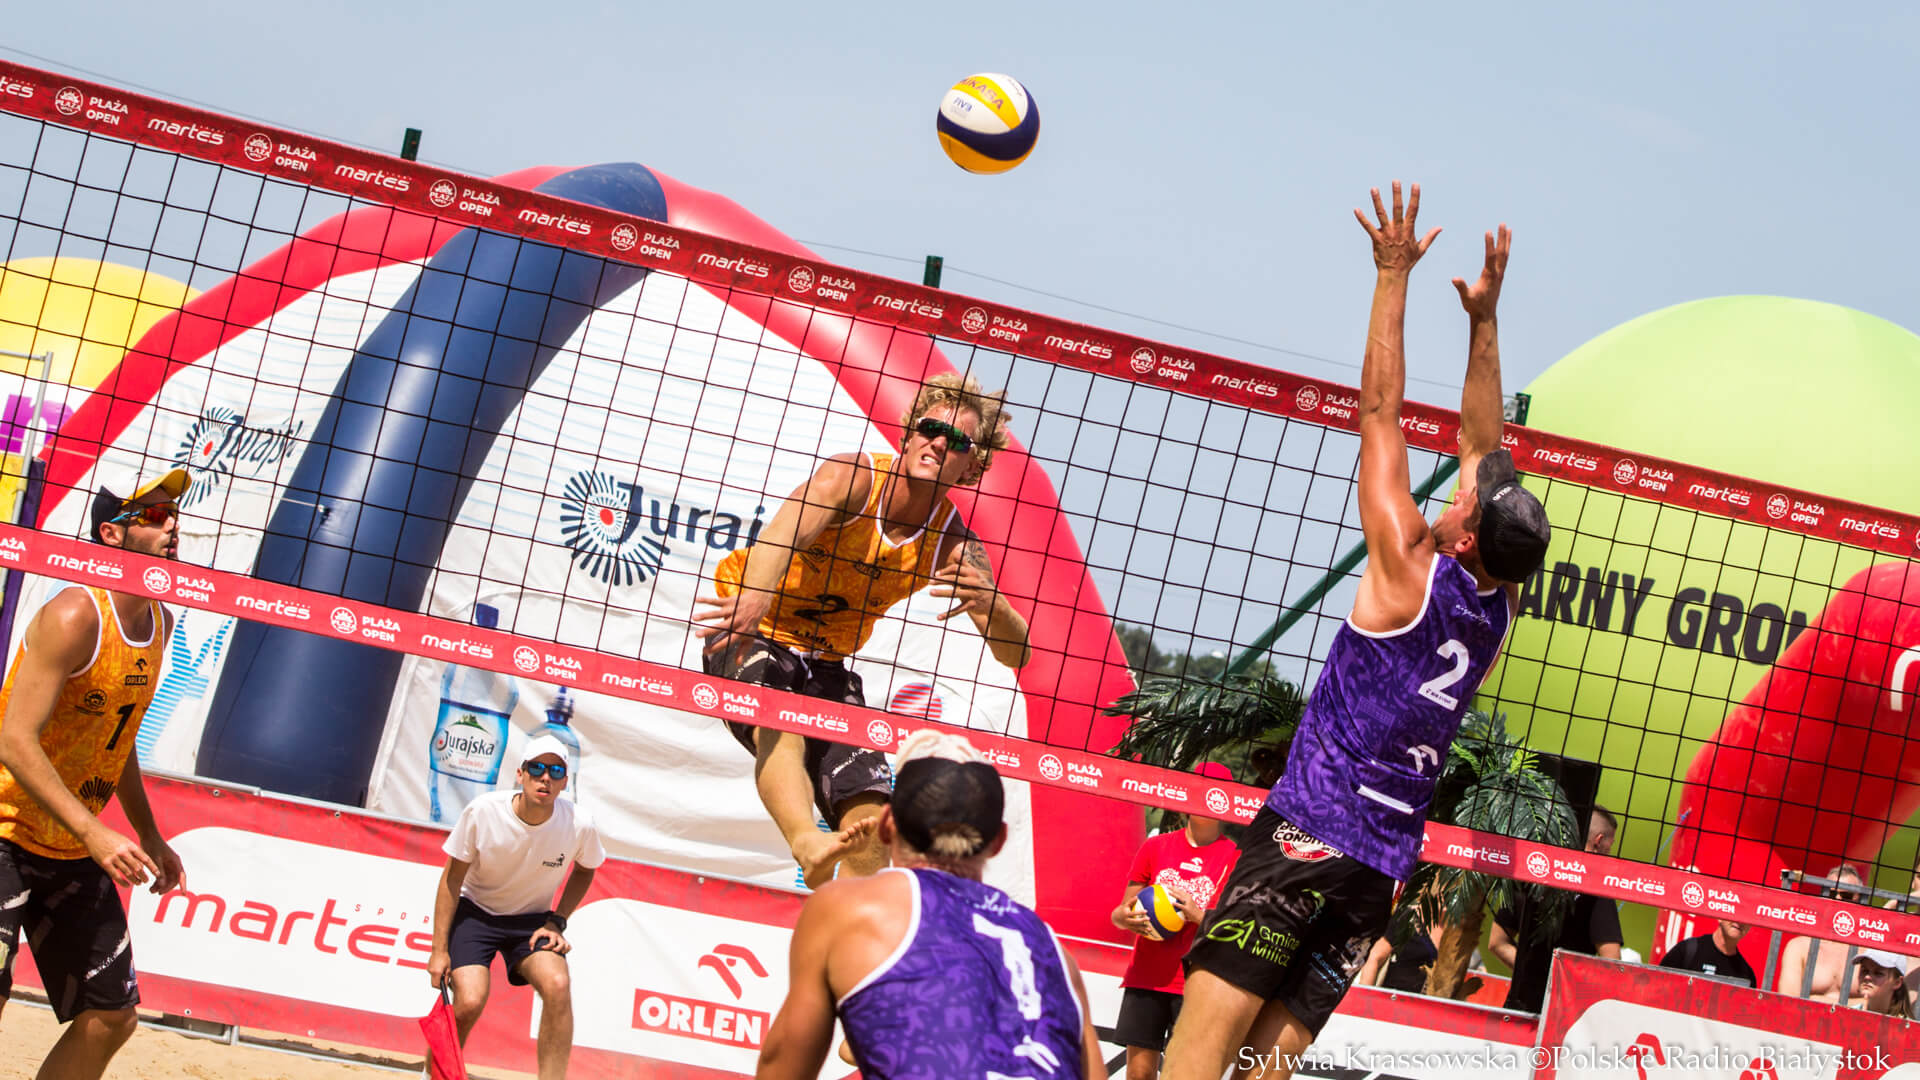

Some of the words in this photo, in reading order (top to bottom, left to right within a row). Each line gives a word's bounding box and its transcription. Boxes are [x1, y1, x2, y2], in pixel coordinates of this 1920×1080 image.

[89, 95, 129, 115] PLAŻA
[86, 110, 119, 126] OPEN
[147, 117, 224, 145] martes
[278, 142, 317, 162] PLAŻA
[275, 156, 308, 172] OPEN
[334, 163, 409, 192] martes
[462, 188, 500, 206] PLAŻA
[459, 201, 492, 216] OPEN
[518, 209, 592, 234] martes
[643, 232, 680, 249] PLAŻA
[640, 245, 672, 260] OPEN
[698, 252, 769, 278] martes
[820, 274, 856, 292] PLAŻA
[817, 287, 848, 301] OPEN
[873, 294, 944, 319] martes
[992, 316, 1028, 332] PLAŻA
[989, 328, 1020, 342] OPEN
[1044, 335, 1112, 360] martes
[1161, 354, 1196, 371] PLAŻA
[1158, 368, 1188, 381] OPEN
[1212, 374, 1278, 397] martes
[1326, 393, 1359, 408] PLAŻA
[1322, 406, 1352, 419] OPEN
[1534, 449, 1598, 471] martes
[1641, 467, 1674, 482] PLAŻA
[1639, 478, 1667, 492] OPEN
[1688, 484, 1750, 506] martes
[1794, 501, 1825, 516] PLAŻA
[1791, 513, 1818, 526] OPEN
[1840, 517, 1899, 539] martes
[47, 554, 124, 579] martes
[176, 575, 216, 592] PLAŻA
[176, 588, 209, 603] OPEN
[236, 595, 310, 620] martes
[794, 594, 849, 626] 2
[362, 616, 401, 632] PLAŻA
[362, 628, 394, 642] OPEN
[421, 634, 493, 659] martes
[545, 654, 582, 670] PLAŻA
[545, 668, 576, 680] OPEN
[1418, 639, 1470, 711] 2
[602, 672, 674, 696] martes
[723, 692, 760, 708] PLAŻA
[723, 703, 754, 718] OPEN
[105, 703, 136, 751] 1
[779, 710, 849, 733] martes
[1068, 763, 1103, 778] PLAŻA
[1068, 775, 1098, 788] OPEN
[1122, 778, 1188, 801] martes
[1234, 796, 1265, 809] PLAŻ
[1234, 807, 1257, 820] OPE
[1448, 843, 1510, 865] martes
[1554, 860, 1586, 874] PLAŻA
[1554, 872, 1582, 884] OPEN
[1603, 874, 1665, 896] martes
[1708, 889, 1740, 904] PLAŻA
[1708, 901, 1735, 914] OPEN
[1756, 904, 1817, 925] martes
[153, 888, 433, 970] martes
[1860, 918, 1889, 932] PLAŻA
[1858, 930, 1884, 942] OPEN
[972, 913, 1042, 1021] 1
[639, 996, 762, 1045] ORLEN
